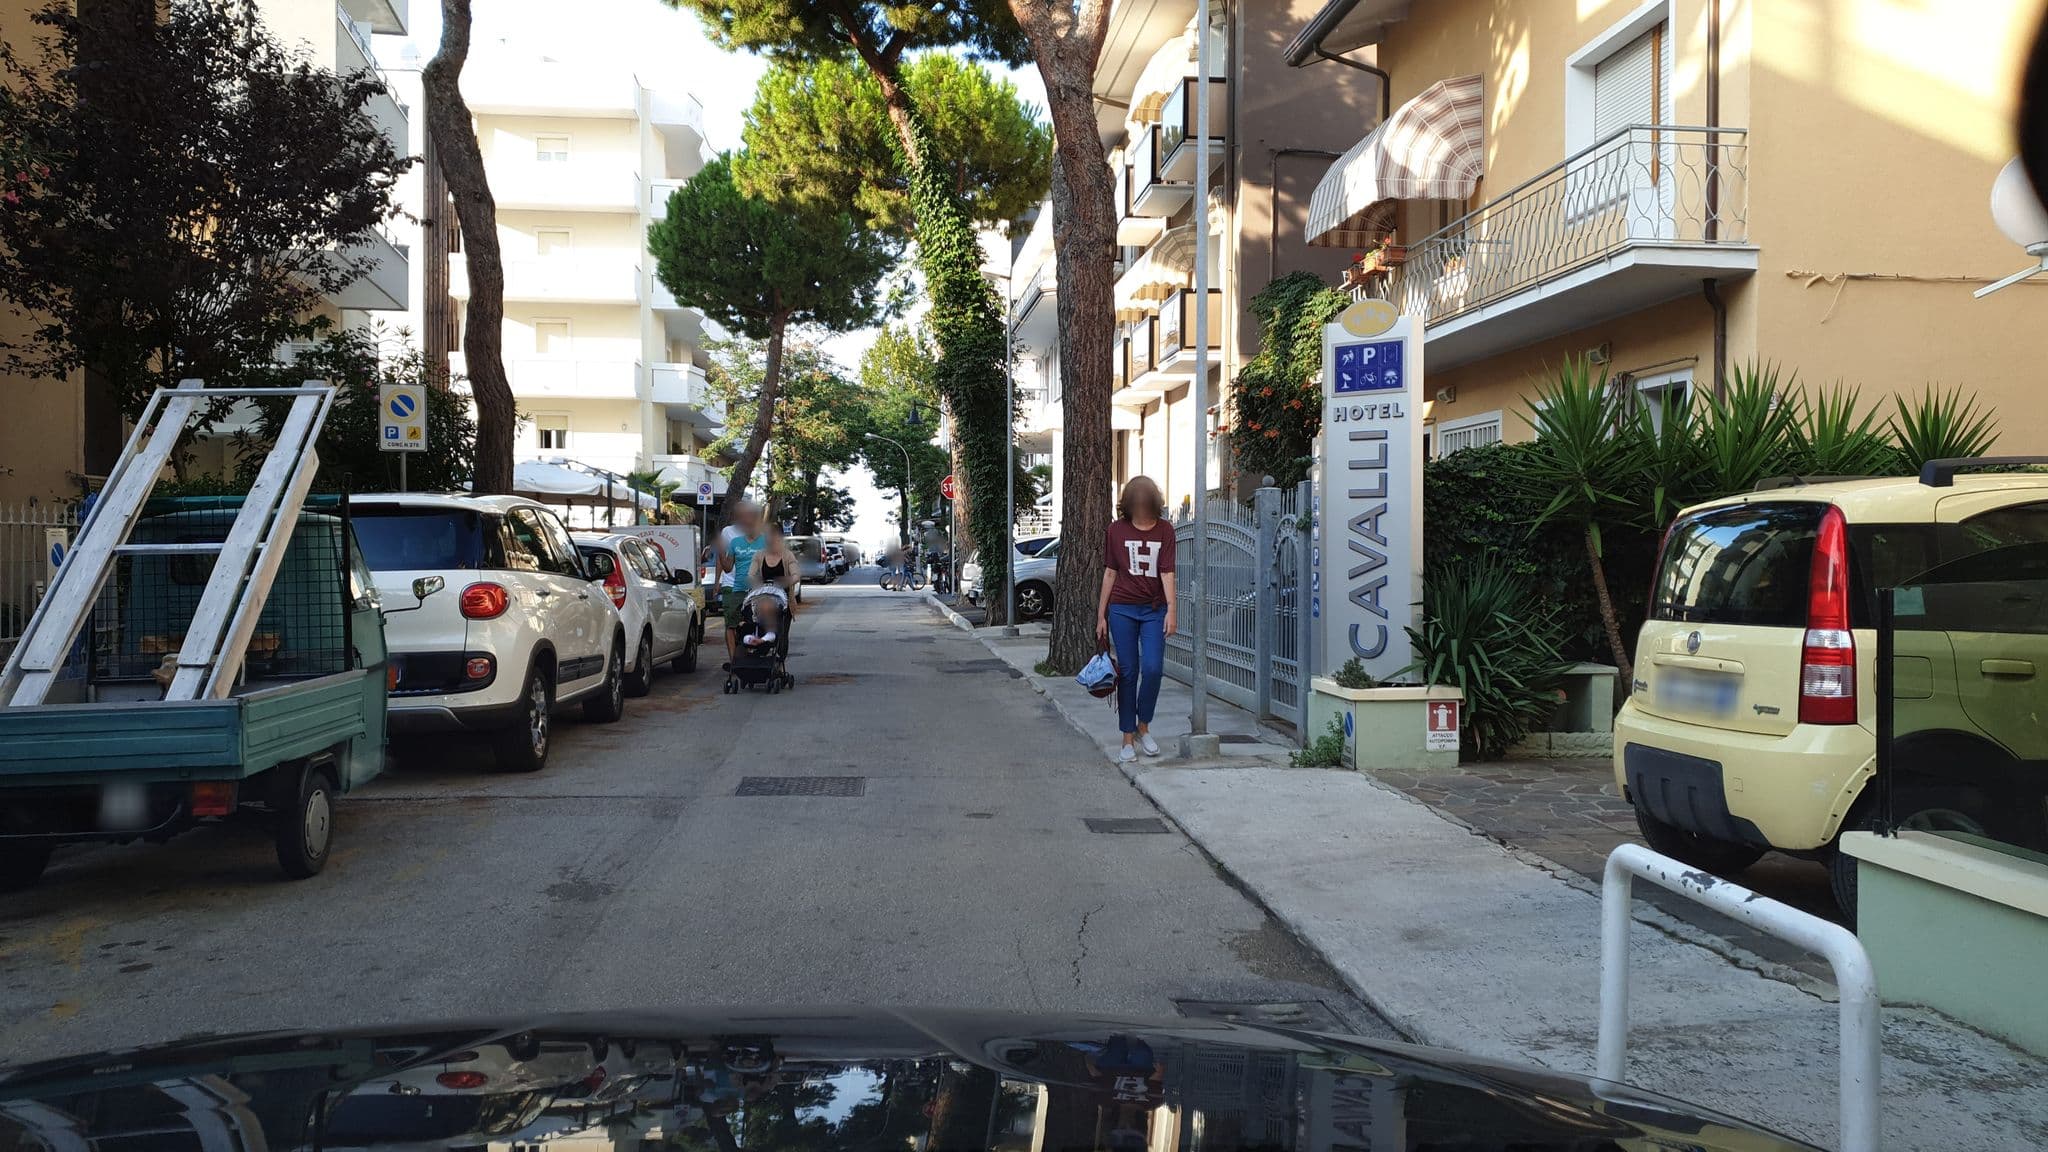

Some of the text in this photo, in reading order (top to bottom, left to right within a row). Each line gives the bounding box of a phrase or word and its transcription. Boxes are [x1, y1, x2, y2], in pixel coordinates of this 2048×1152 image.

[1363, 347, 1376, 365] P
[1333, 402, 1404, 422] HOTEL
[388, 428, 396, 437] P
[1348, 429, 1388, 660] CAVALLI
[1125, 541, 1162, 578] H
